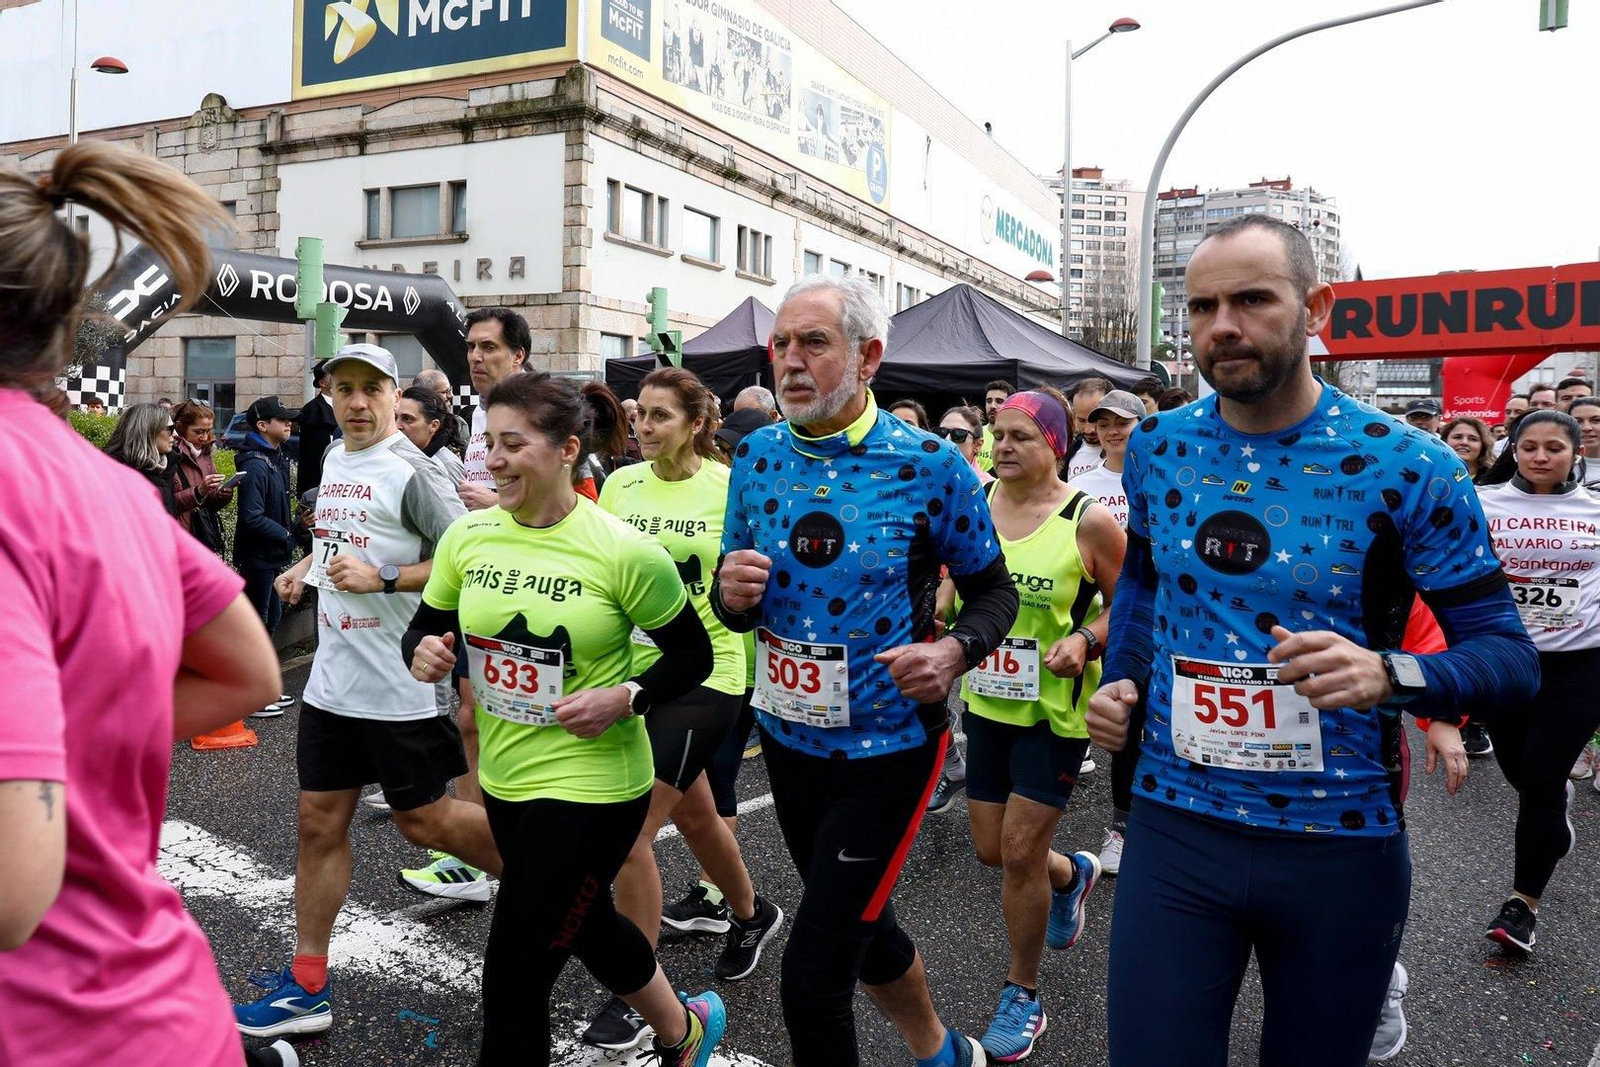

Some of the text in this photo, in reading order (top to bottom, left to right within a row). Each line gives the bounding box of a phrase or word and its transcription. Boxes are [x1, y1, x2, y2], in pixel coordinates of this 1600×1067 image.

[629, 3, 636, 14] TO
[609, 6, 644, 40] McFIT
[711, 2, 751, 32] GIMNASIO
[753, 22, 763, 38] DE
[764, 29, 791, 52] GALICIA
[608, 54, 644, 79] mcfit.com
[996, 206, 1054, 269] MERCADONA
[250, 269, 393, 312] ROOSA
[1453, 395, 1486, 406] Sports
[1451, 409, 1501, 418] Santander
[319, 483, 372, 501] CARREIRA
[1232, 482, 1249, 492] IN
[1313, 487, 1366, 502] RUN TRI
[664, 519, 707, 537] auga
[1301, 515, 1354, 531] RUN TRI
[1488, 517, 1597, 535] VI CARREIRA
[1509, 557, 1595, 572] Santander
[502, 569, 522, 595] que
[523, 574, 583, 603] auga
[1035, 593, 1052, 602] Vigo
[1513, 586, 1562, 608] 326
[484, 654, 539, 694] 633
[767, 651, 821, 694] 503
[1194, 683, 1276, 729] 551
